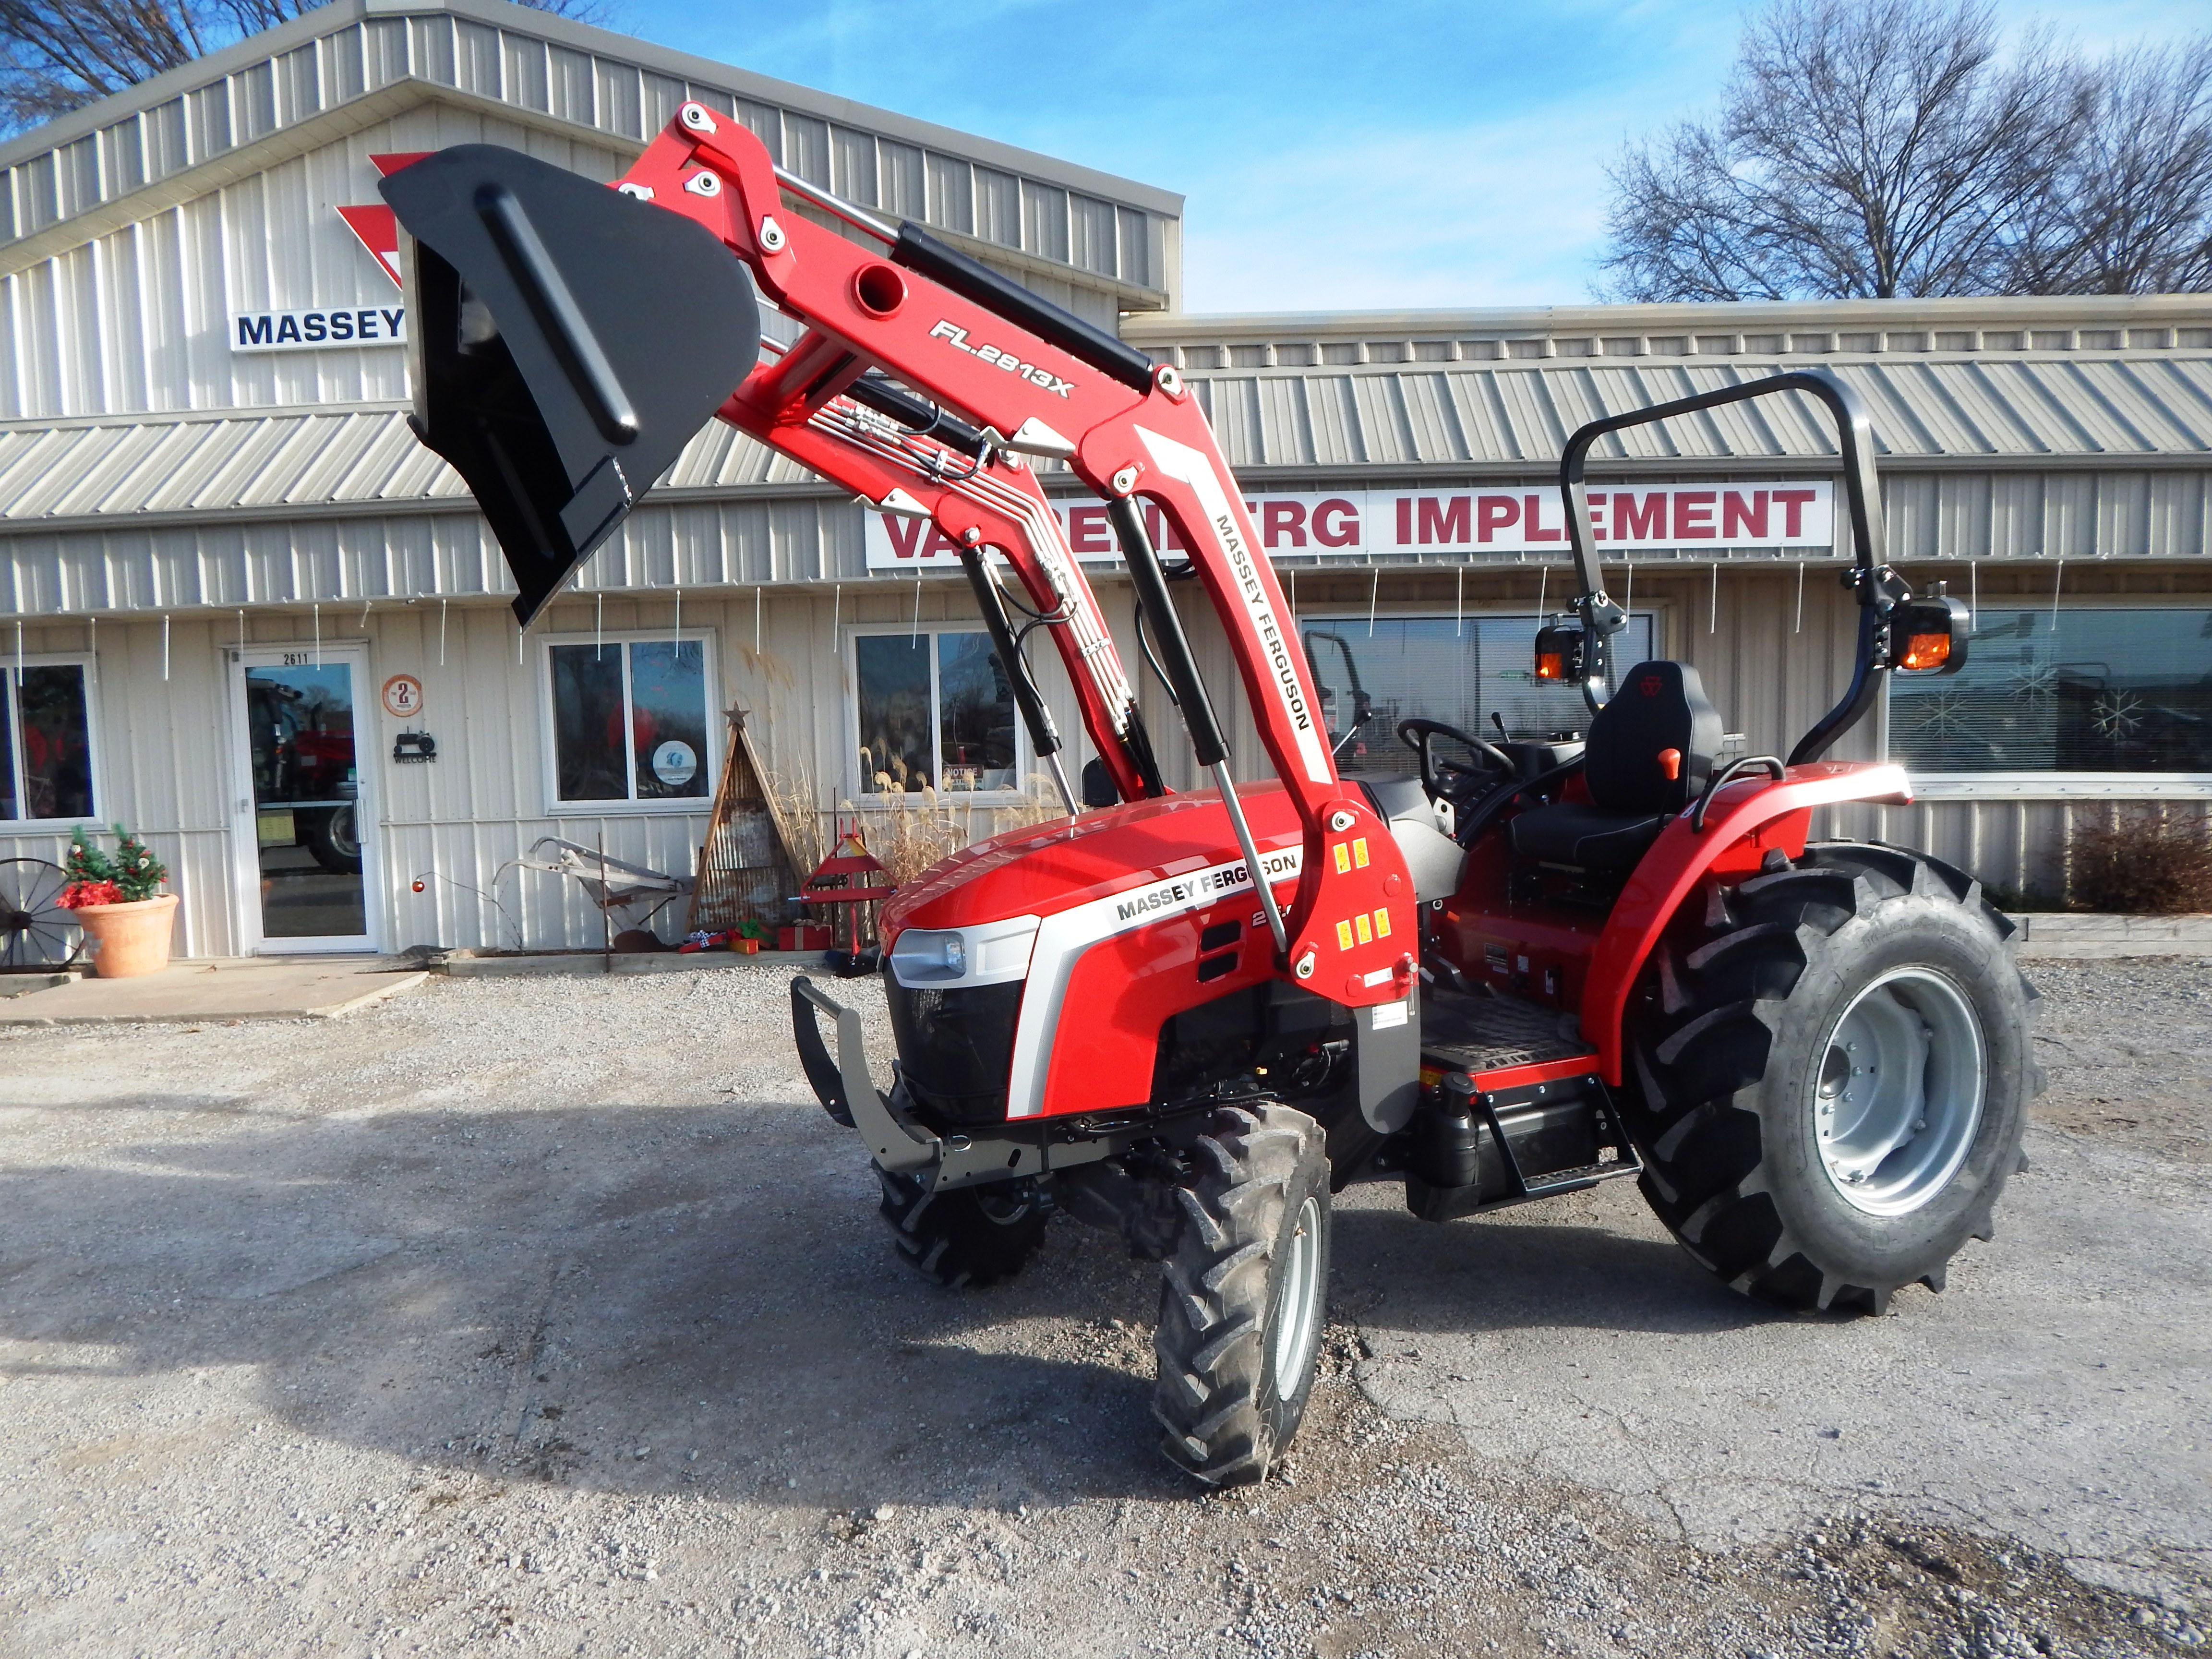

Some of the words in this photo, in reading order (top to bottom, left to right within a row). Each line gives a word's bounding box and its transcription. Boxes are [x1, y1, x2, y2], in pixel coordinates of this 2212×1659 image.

[238, 309, 404, 345] MASSEY
[929, 319, 1076, 399] FL.2813X
[1217, 515, 1263, 604] MASSEY
[1259, 614, 1310, 730] FERGUSON
[284, 653, 308, 665] 2611
[398, 683, 409, 703] 2
[1117, 881, 1194, 921] MASSEY
[1201, 854, 1297, 892] FERGSON
